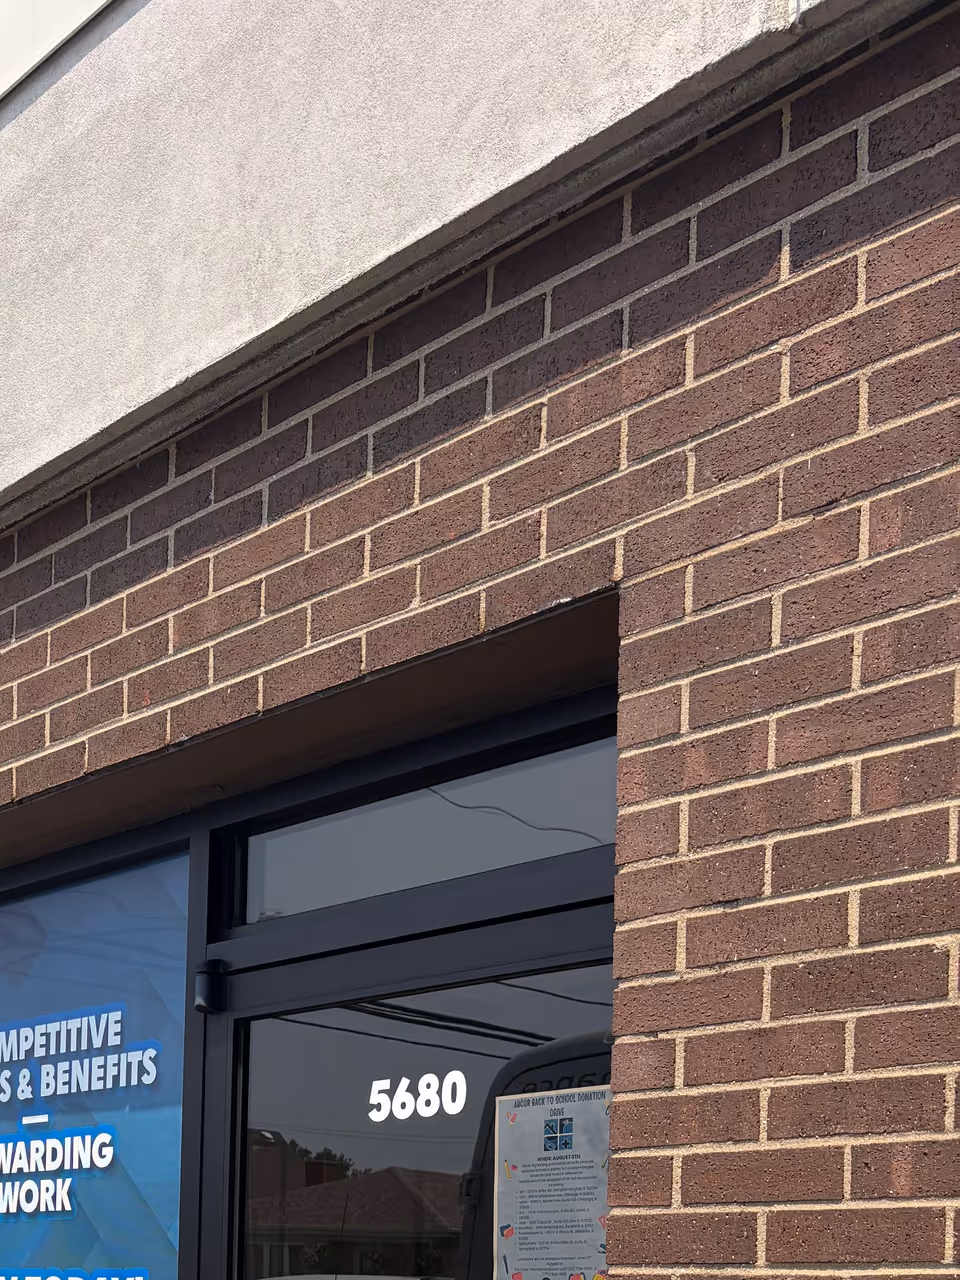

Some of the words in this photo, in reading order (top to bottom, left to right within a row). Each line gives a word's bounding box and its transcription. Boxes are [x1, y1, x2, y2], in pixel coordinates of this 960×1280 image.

[17, 1069, 33, 1100] &
[41, 1048, 157, 1097] BENEFITS
[367, 1069, 467, 1122] 5680
[514, 1100, 530, 1108] ABCOR
[532, 1097, 545, 1106] BACK
[547, 1096, 553, 1105] TO
[555, 1094, 576, 1104] SCHOOL
[578, 1091, 606, 1102] DONATION
[550, 1107, 564, 1117] DRIVE
